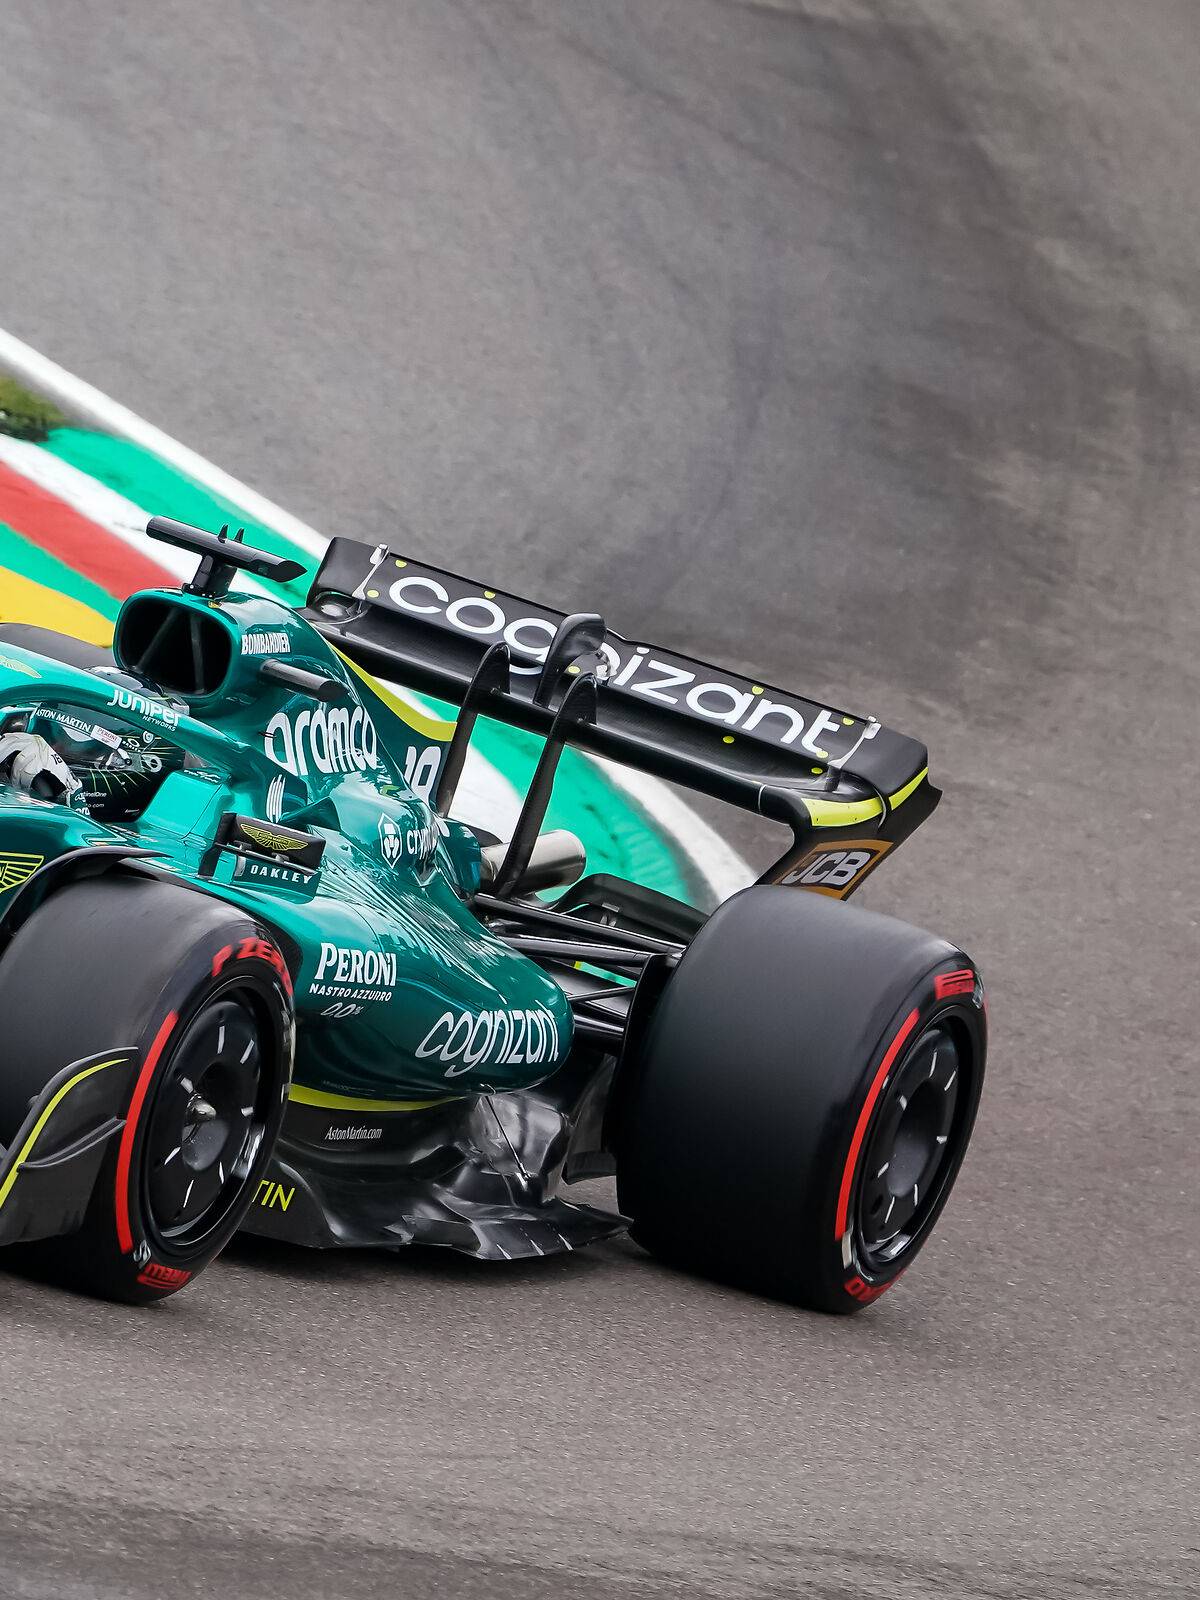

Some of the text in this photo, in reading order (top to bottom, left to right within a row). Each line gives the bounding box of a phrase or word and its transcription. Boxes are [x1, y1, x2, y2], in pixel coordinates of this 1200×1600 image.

[241, 632, 291, 655] BOMBARDIER
[388, 576, 841, 753] cogizant
[56, 713, 91, 733] MARTIN
[142, 715, 176, 732] NETWORKS
[264, 705, 377, 776] aramco
[250, 864, 313, 884] OAKLEY
[781, 851, 871, 886] JCB
[314, 942, 397, 986] PERONI
[309, 983, 393, 1002] NASTRO AZZURRO
[415, 994, 560, 1077] cognizant
[324, 1125, 383, 1140] AstonMartin.com
